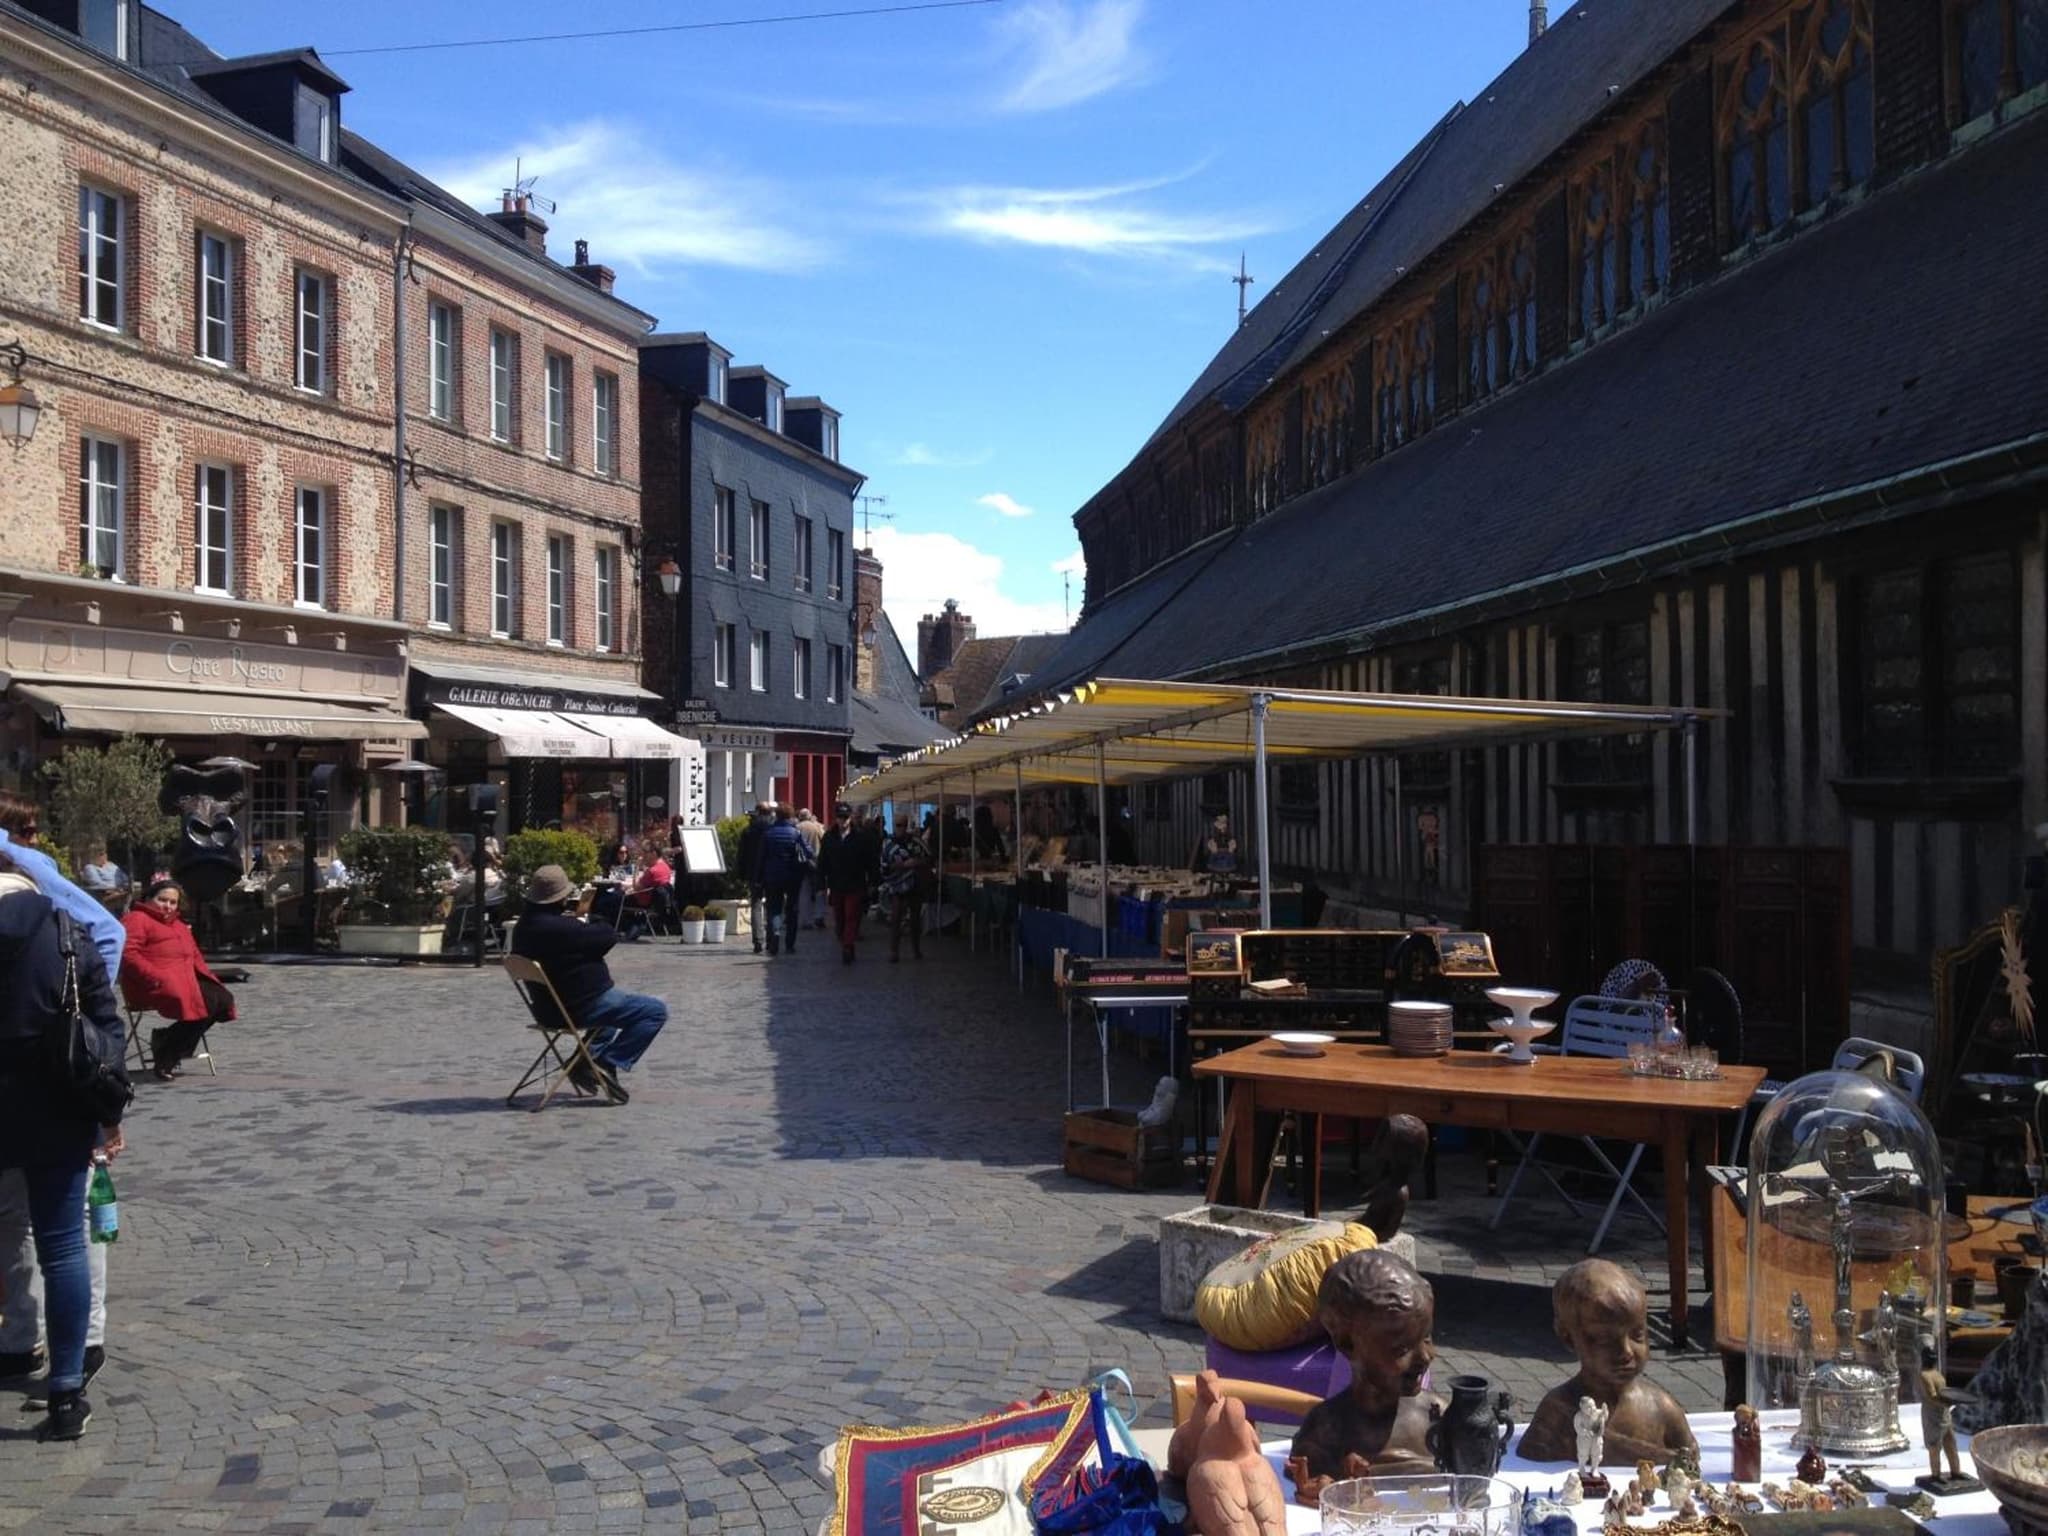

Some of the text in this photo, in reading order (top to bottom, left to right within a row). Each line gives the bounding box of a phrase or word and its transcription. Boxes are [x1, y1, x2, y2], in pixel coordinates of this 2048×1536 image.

[231, 647, 286, 681] Resto
[448, 687, 499, 704] GALERIE
[209, 716, 315, 735] RESTAURANT
